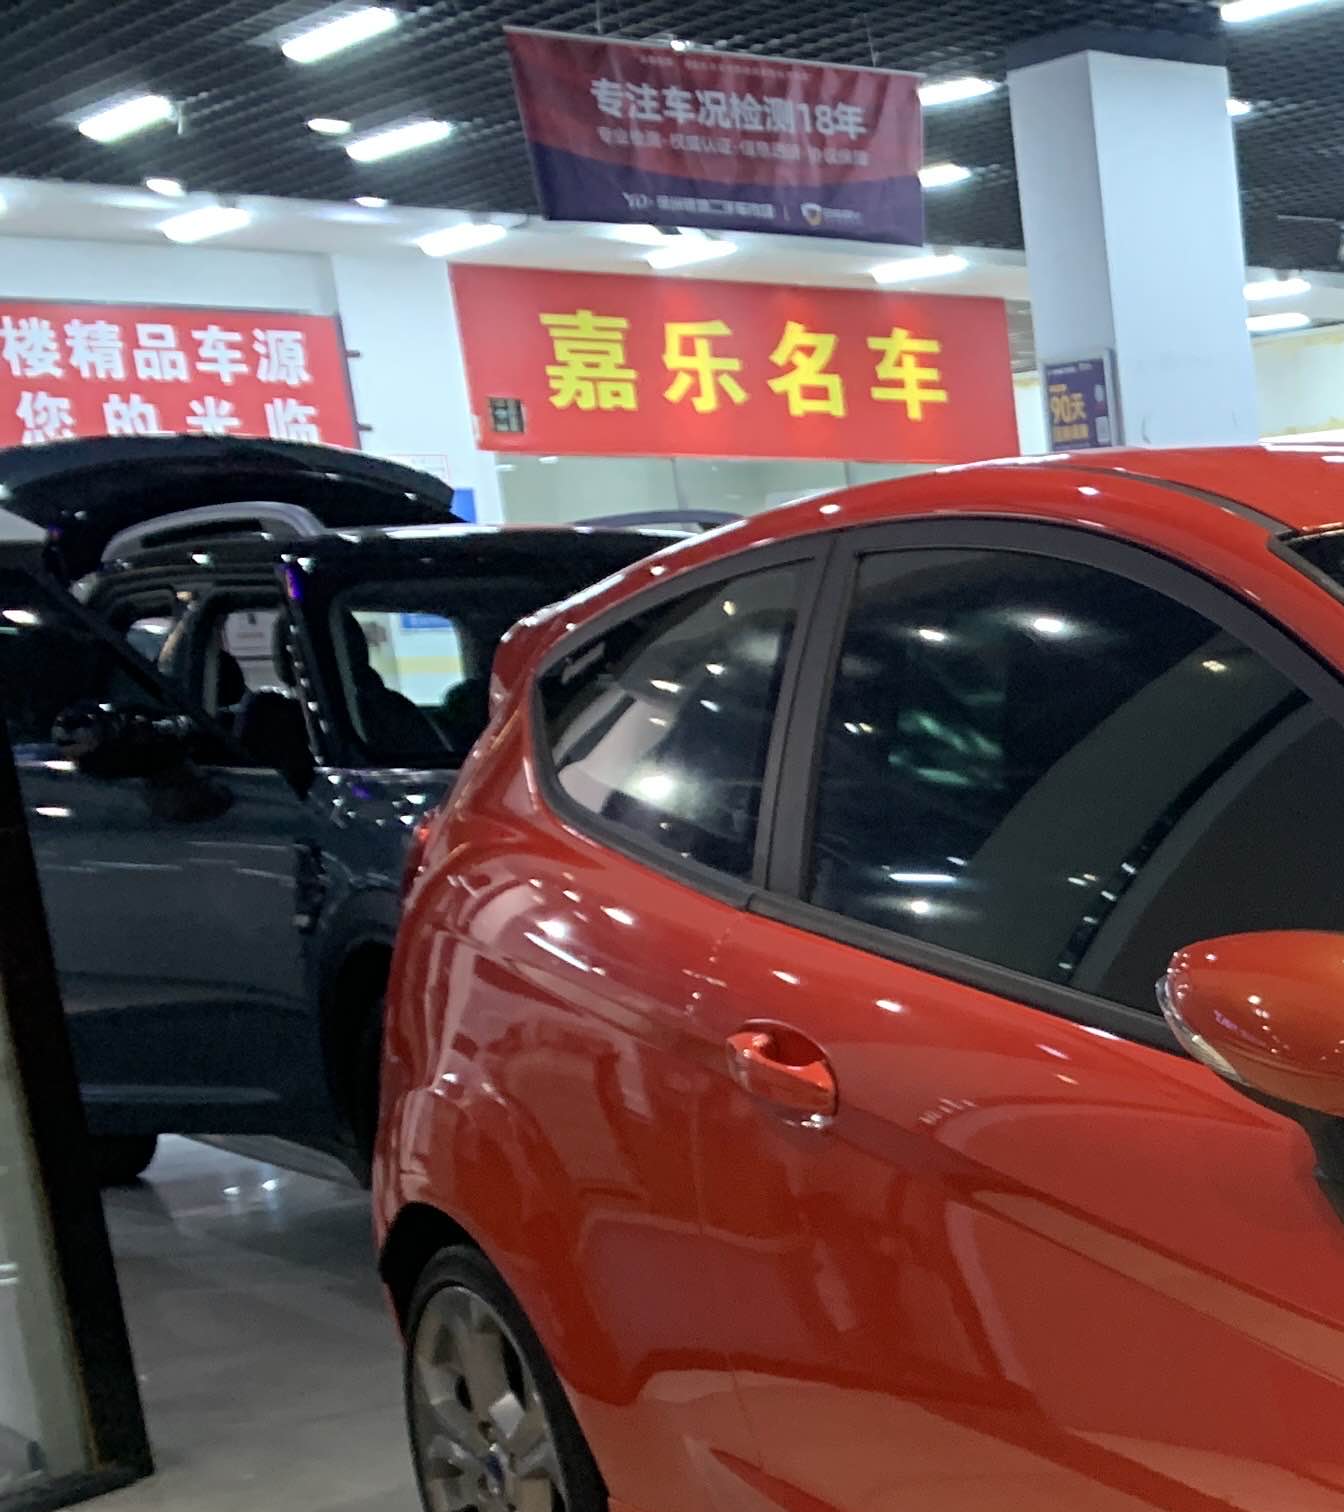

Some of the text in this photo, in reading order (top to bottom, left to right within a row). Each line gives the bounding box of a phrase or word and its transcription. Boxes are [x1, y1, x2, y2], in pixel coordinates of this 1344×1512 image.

[590, 77, 867, 141] 专注车况检测18年
[0, 315, 314, 387] 楼精品车源
[539, 309, 949, 421] 嘉乐名车
